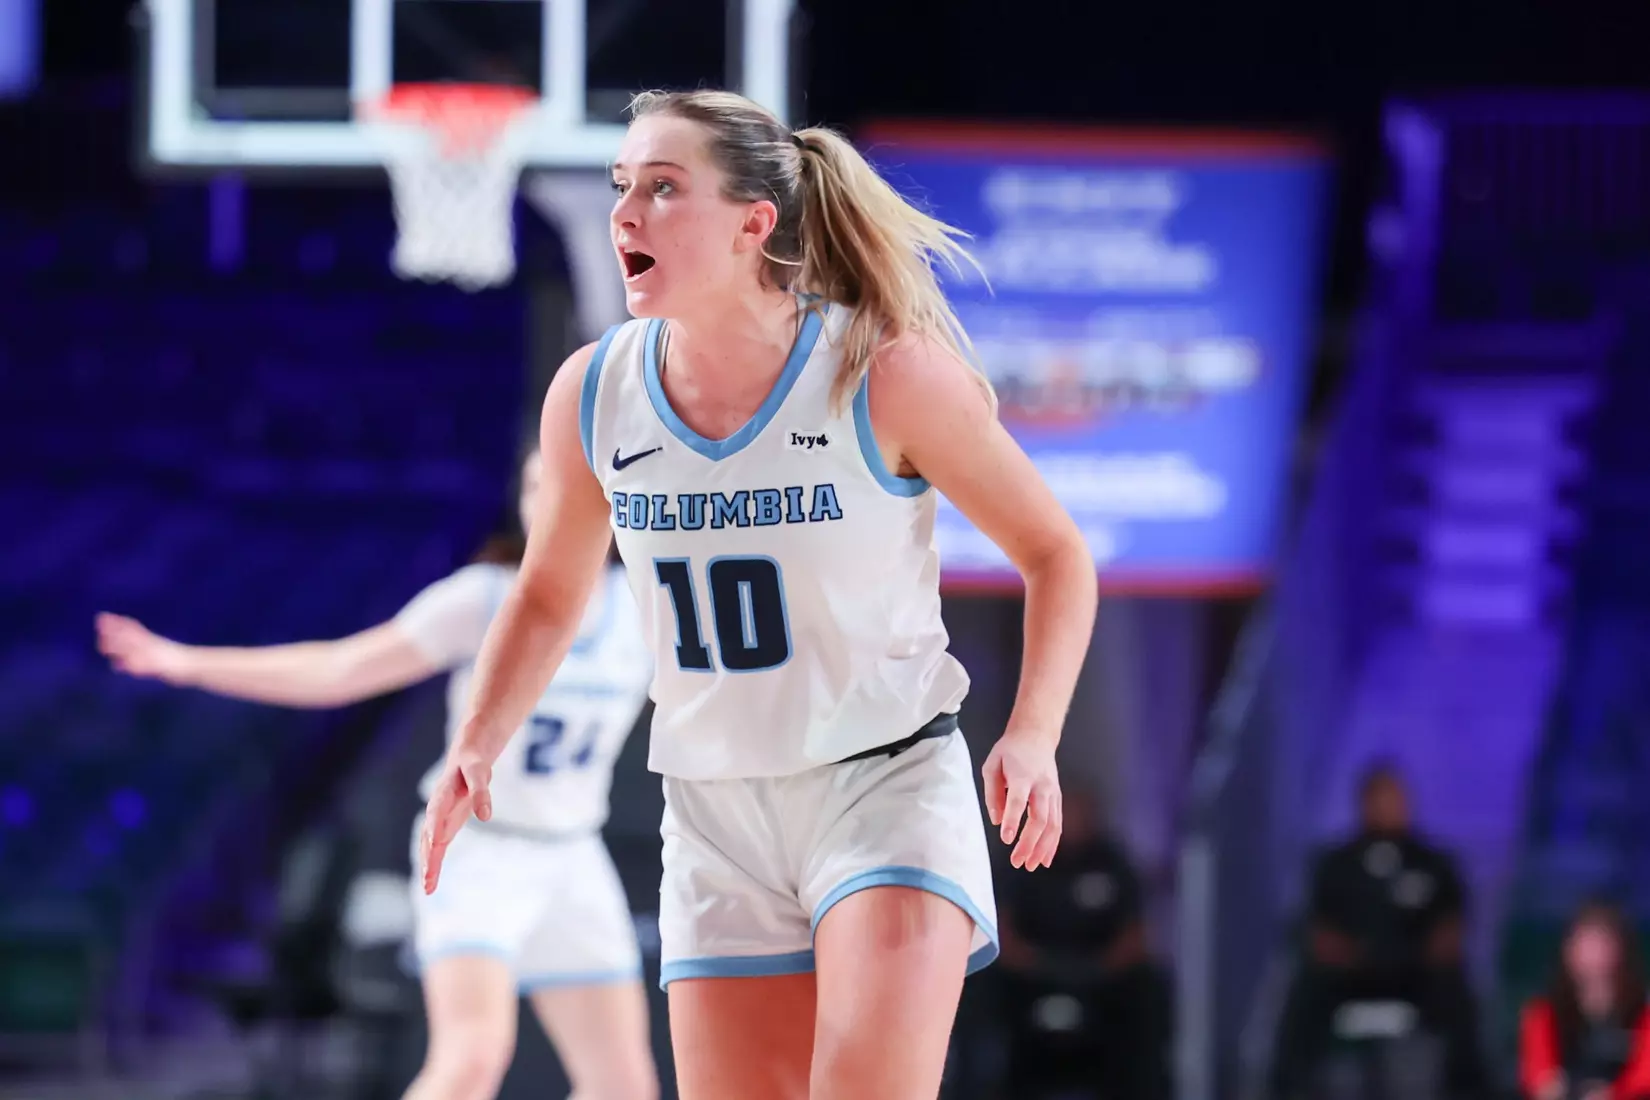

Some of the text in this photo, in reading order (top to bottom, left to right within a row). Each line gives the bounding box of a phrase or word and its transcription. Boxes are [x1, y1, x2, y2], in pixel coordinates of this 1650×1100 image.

[791, 432, 816, 449] Ivy
[612, 483, 843, 531] COLUMBIA
[652, 554, 793, 674] 10
